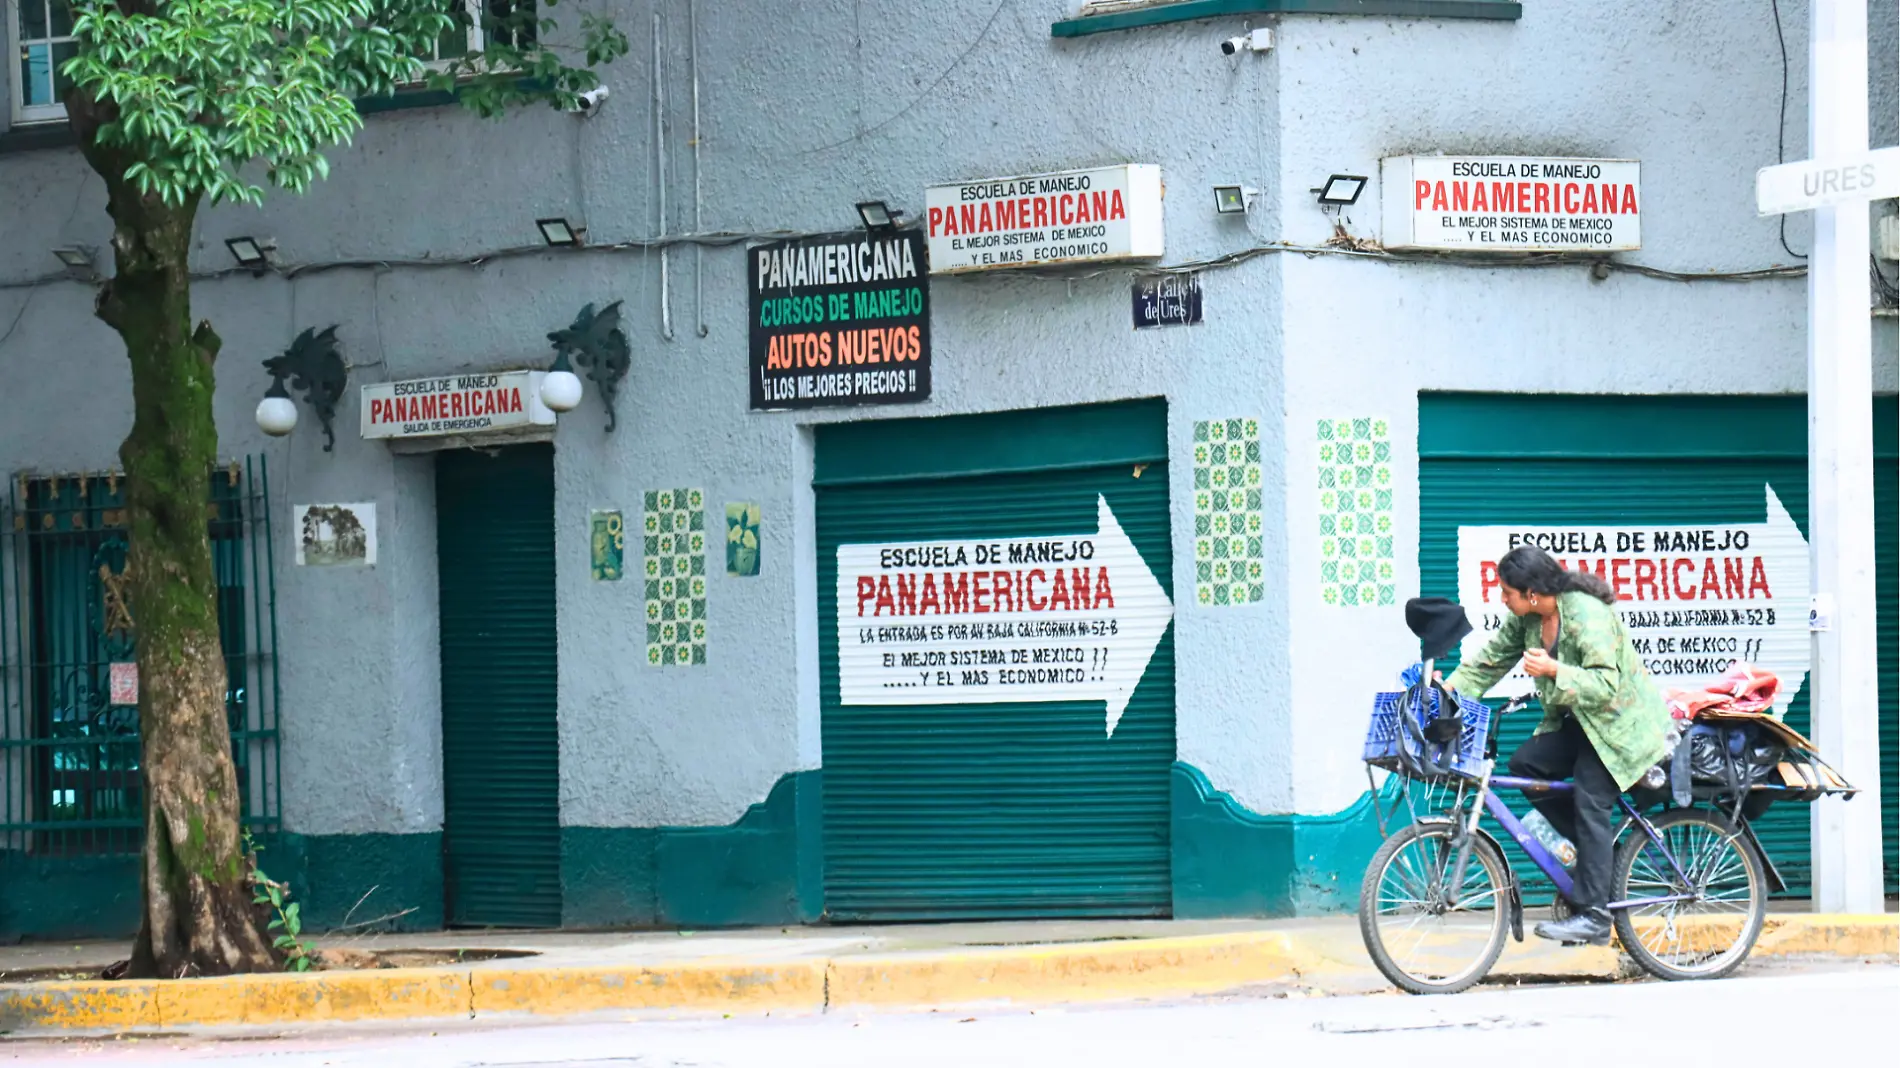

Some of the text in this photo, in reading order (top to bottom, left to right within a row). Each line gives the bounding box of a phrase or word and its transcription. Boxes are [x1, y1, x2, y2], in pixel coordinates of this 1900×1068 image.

[1453, 162, 1600, 179] ESCUELA DE MANEJO
[1803, 163, 1876, 197] URES
[961, 175, 1091, 201] ESCUELA DE MANEJO
[1415, 180, 1638, 215] PANAMERICANA
[928, 189, 1126, 238] PANAMERICANA
[1442, 216, 1612, 230] EL MEJOR SISTEMA DE MEXICO
[952, 225, 1105, 250] EL MEJOR SISTEMA DE MEXICO
[1467, 231, 1475, 242] Y
[1480, 231, 1496, 242] EL
[1501, 231, 1528, 243] MAS
[1534, 232, 1612, 244] ECONOMICO
[758, 238, 917, 289] PANAMERICANA
[972, 254, 978, 265] Y
[982, 252, 996, 264] EL
[1000, 249, 1023, 262] MAS
[1034, 242, 1108, 260] ECONOMICO
[761, 287, 923, 327] CURSOS DE MANEJO
[1145, 300, 1187, 319] de Ures
[767, 325, 921, 370] AUTOS NUEVOS
[394, 375, 498, 396] ESCUELA DE MANEJO
[773, 375, 795, 400] LOS
[798, 372, 852, 399] MEJORES
[855, 370, 906, 395] PRECIOS
[908, 369, 916, 392] !!
[371, 387, 523, 424] PANAMERICANA
[403, 417, 492, 434] SALIDA DE EMERGENCIA
[880, 540, 1095, 568] ESCUELA DE MANEJO
[1509, 530, 1750, 554] ESCUELA DE MANEJO
[857, 566, 1115, 617] PANAMERICANA
[1629, 610, 1660, 628] BAJA
[1664, 609, 1730, 627] CALIFORNIA
[859, 628, 874, 643] LA
[878, 625, 928, 643] ENTRADA
[930, 625, 944, 640] ES
[948, 623, 968, 640] POR
[986, 621, 1014, 640] BAJA
[1017, 620, 1076, 638] CALIFORNIA
[901, 651, 945, 667] MEJOR
[950, 649, 1006, 666] SISTEMA
[1011, 649, 1028, 664] DE
[1032, 647, 1084, 663] MEXICO
[1656, 637, 1676, 653] DE
[1680, 637, 1737, 653] MEXICO
[937, 671, 954, 686] EL
[961, 670, 988, 685] MAS
[999, 668, 1084, 683] ECONOMICO
